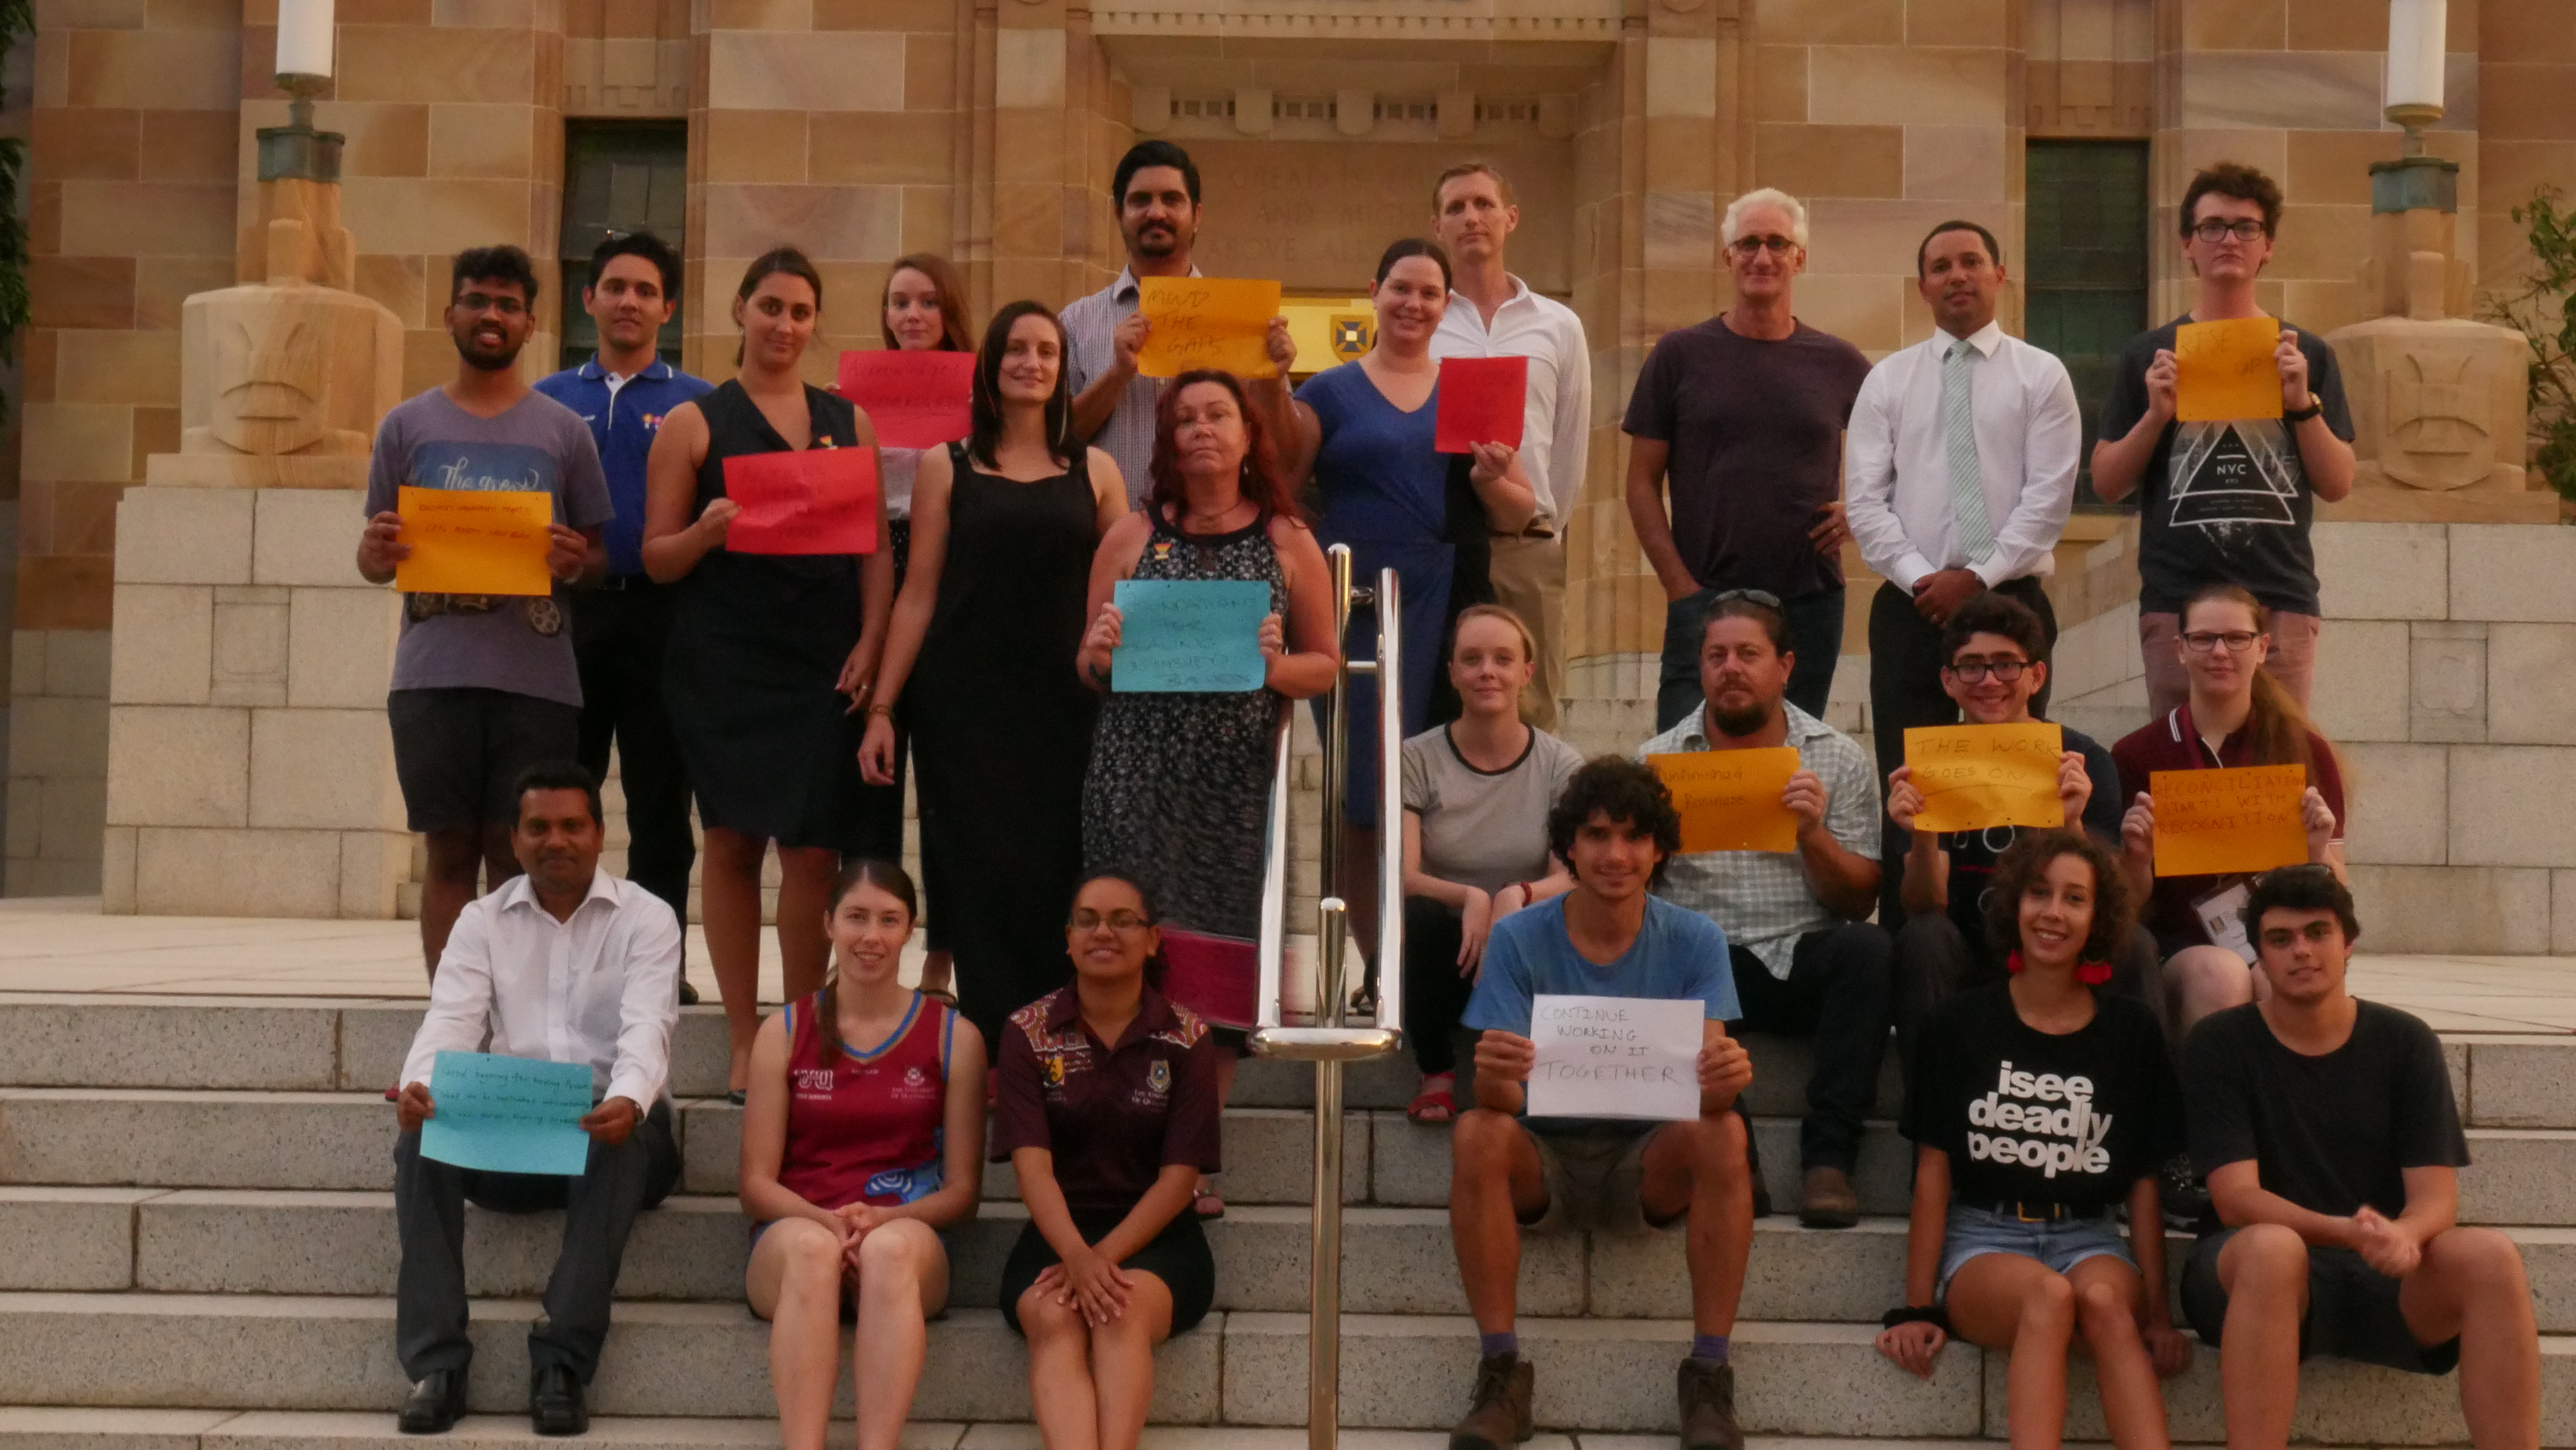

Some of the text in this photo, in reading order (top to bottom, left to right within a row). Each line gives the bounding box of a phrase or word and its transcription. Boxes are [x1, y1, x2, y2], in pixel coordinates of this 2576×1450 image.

[1156, 313, 1203, 331] THE
[2216, 464, 2247, 475] NYC
[1915, 737, 1970, 754] THE
[1923, 764, 2026, 780] GOES ON
[2236, 793, 2287, 808] WITH
[1540, 1003, 1629, 1022] CONTINUE
[1556, 1024, 1637, 1041] WORKING
[1589, 1044, 1650, 1057] ON IT
[1538, 1059, 1682, 1086] TOGETHER
[1968, 1091, 2113, 1146] deadly
[1967, 1131, 2111, 1179] people
